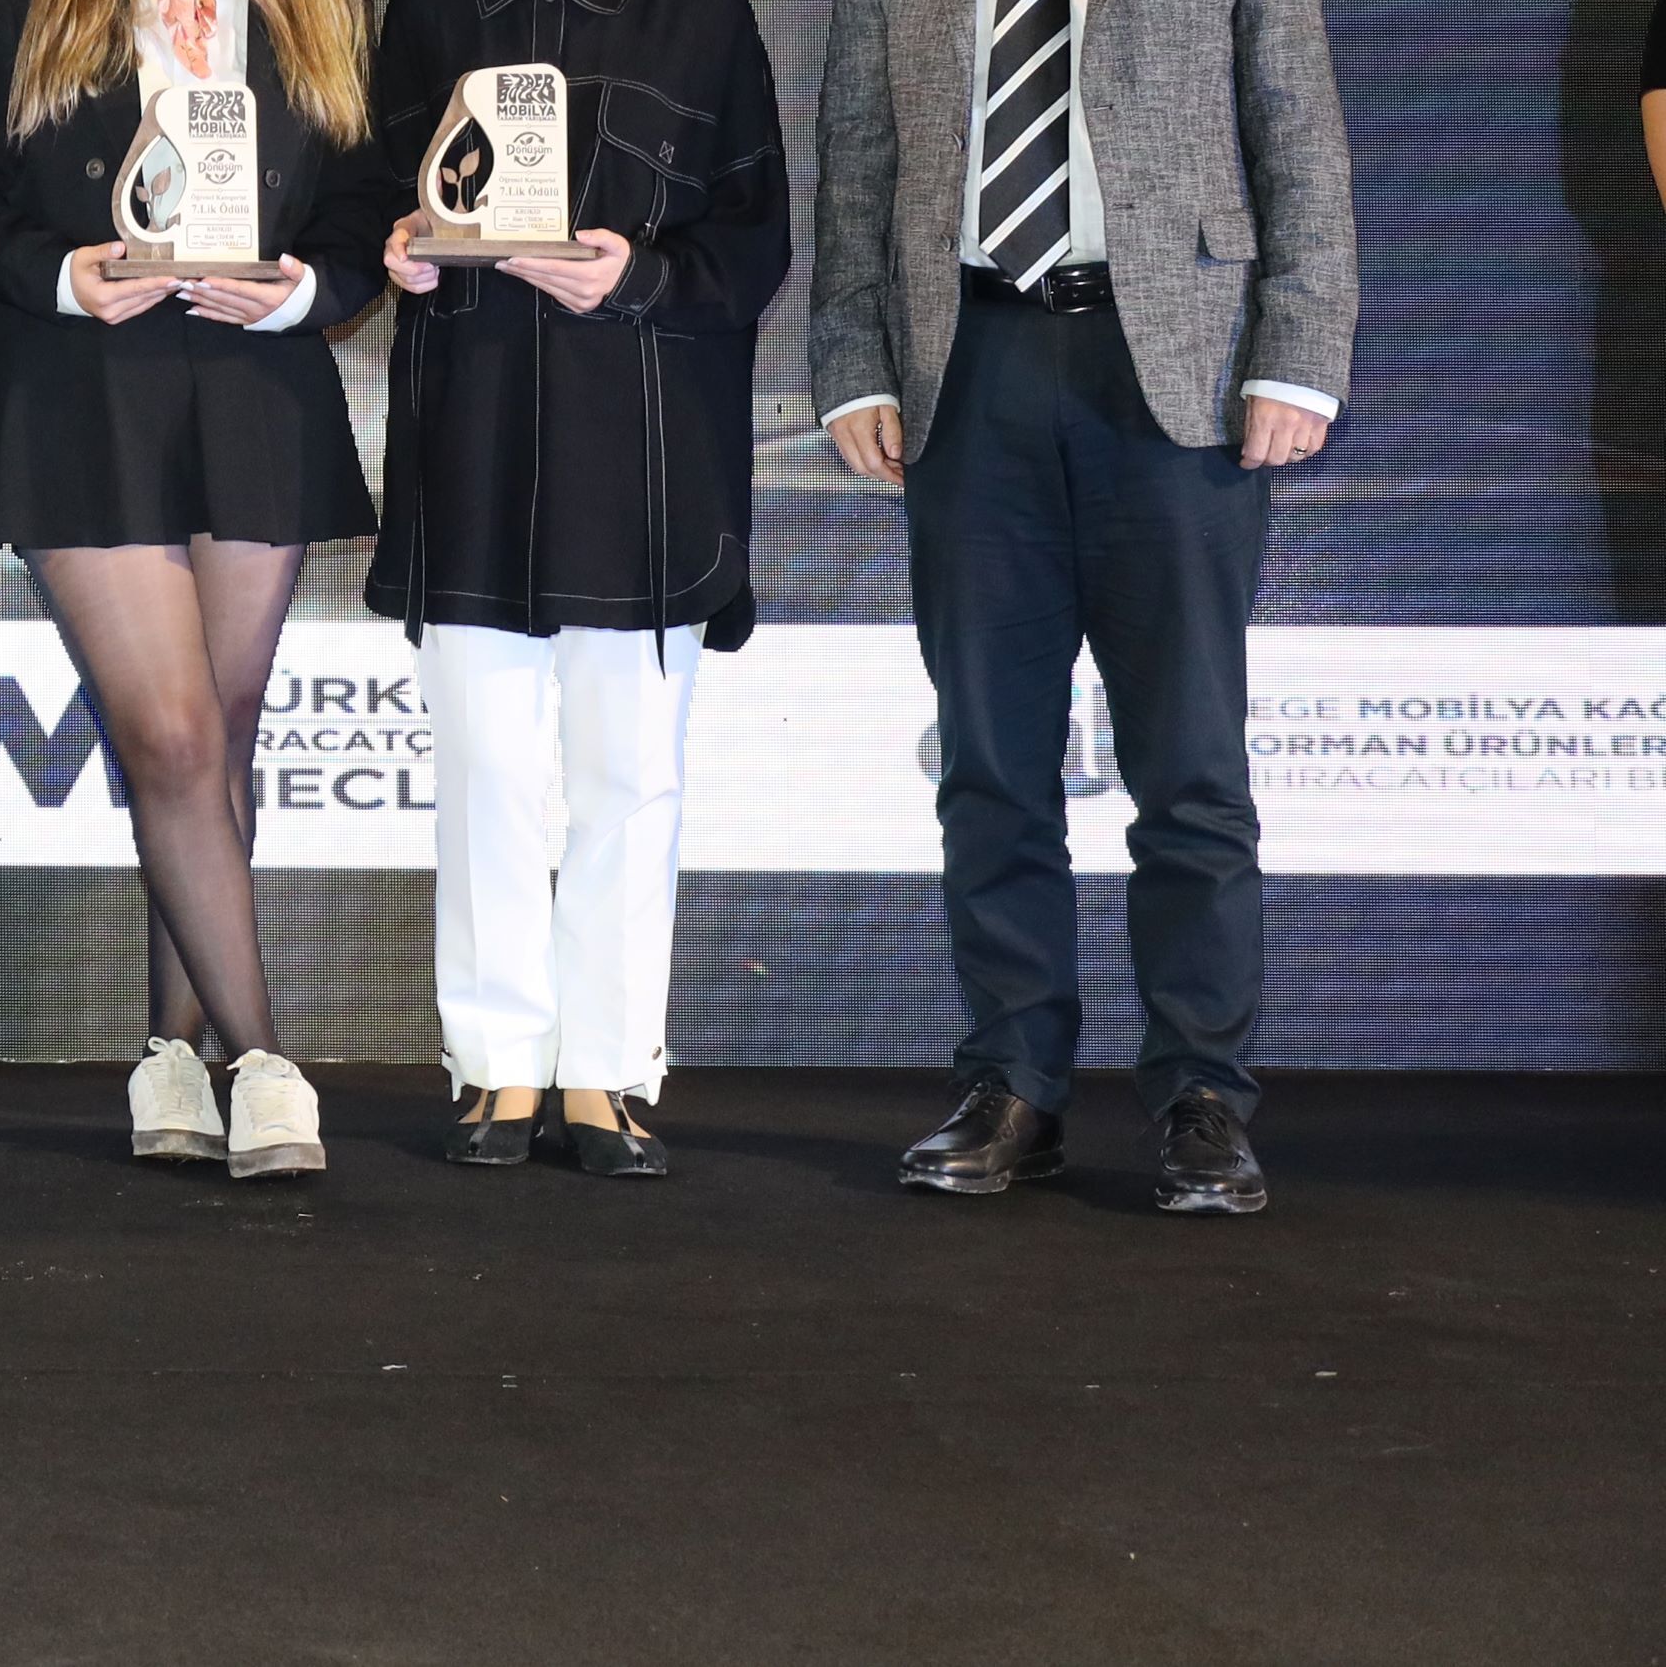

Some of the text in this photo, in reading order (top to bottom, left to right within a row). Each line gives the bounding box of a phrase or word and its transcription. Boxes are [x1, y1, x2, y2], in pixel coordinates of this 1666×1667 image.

[497, 105, 556, 117] MOBİLYA
[188, 122, 246, 134] MOBİLYA
[506, 144, 553, 156] Dönüşüm
[197, 161, 243, 174] Dönüşüm
[500, 185, 559, 196] 7.Lik Ödülü
[192, 202, 250, 214] 7.Lik Ödülü
[1249, 697, 1341, 720] EGE
[1357, 692, 1566, 720] MOBİLYA
[1249, 733, 1428, 756] ORMAN
